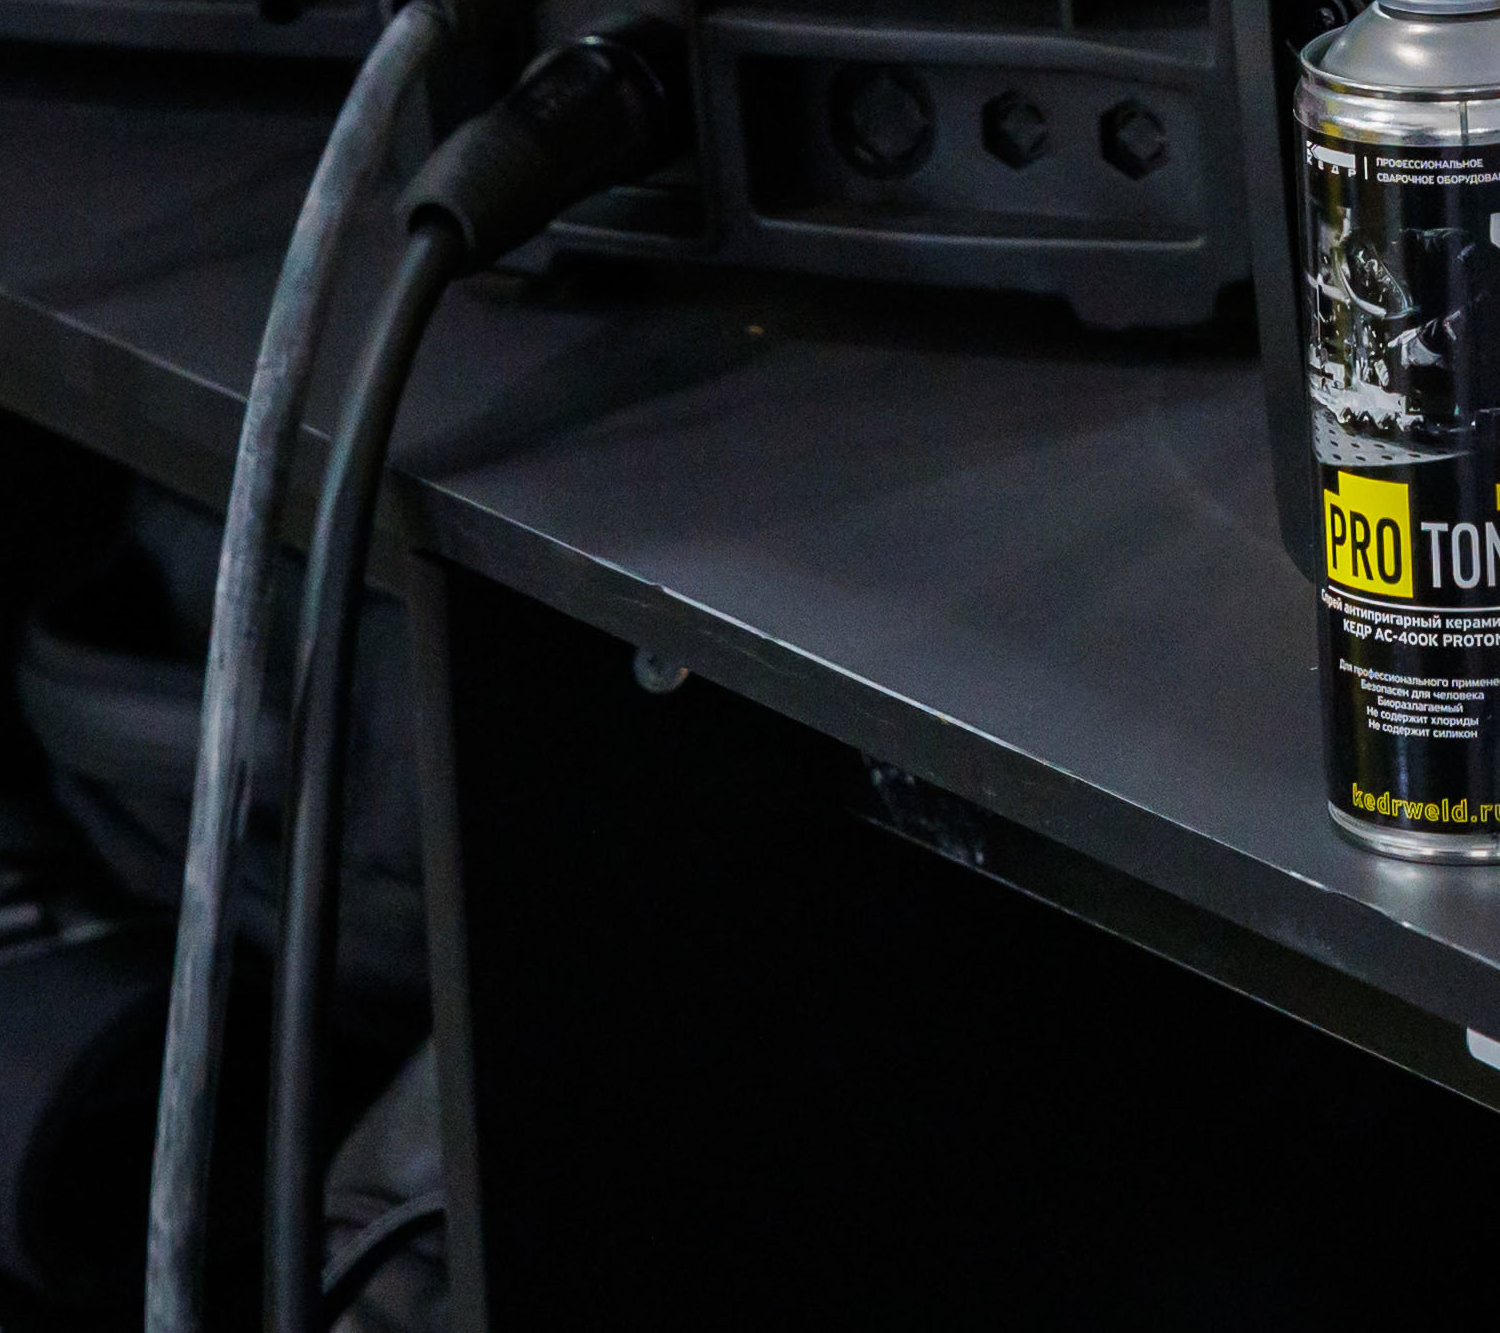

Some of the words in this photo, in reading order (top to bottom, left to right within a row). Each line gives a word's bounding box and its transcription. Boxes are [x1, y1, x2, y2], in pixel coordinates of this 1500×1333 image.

[1376, 156, 1484, 170] ПРОФЕССИОНАЛЬНОЕ
[1377, 171, 1435, 184] СВАРОЧНОЕ
[1321, 587, 1343, 612] Спрей
[1343, 603, 1442, 630] антипригарный
[1343, 618, 1372, 641] КЕДР
[1353, 664, 1449, 689] профессионального
[1360, 678, 1409, 698] Безопасен
[1411, 688, 1431, 700] для
[1432, 690, 1485, 701] человека
[1377, 695, 1464, 714] Биоразлагаемый
[1366, 705, 1379, 718] Не
[1380, 709, 1428, 726] содержит
[1430, 715, 1479, 727] хлориды
[1368, 718, 1380, 731] Не
[1382, 722, 1430, 738] содержит
[1432, 728, 1478, 739] силикон
